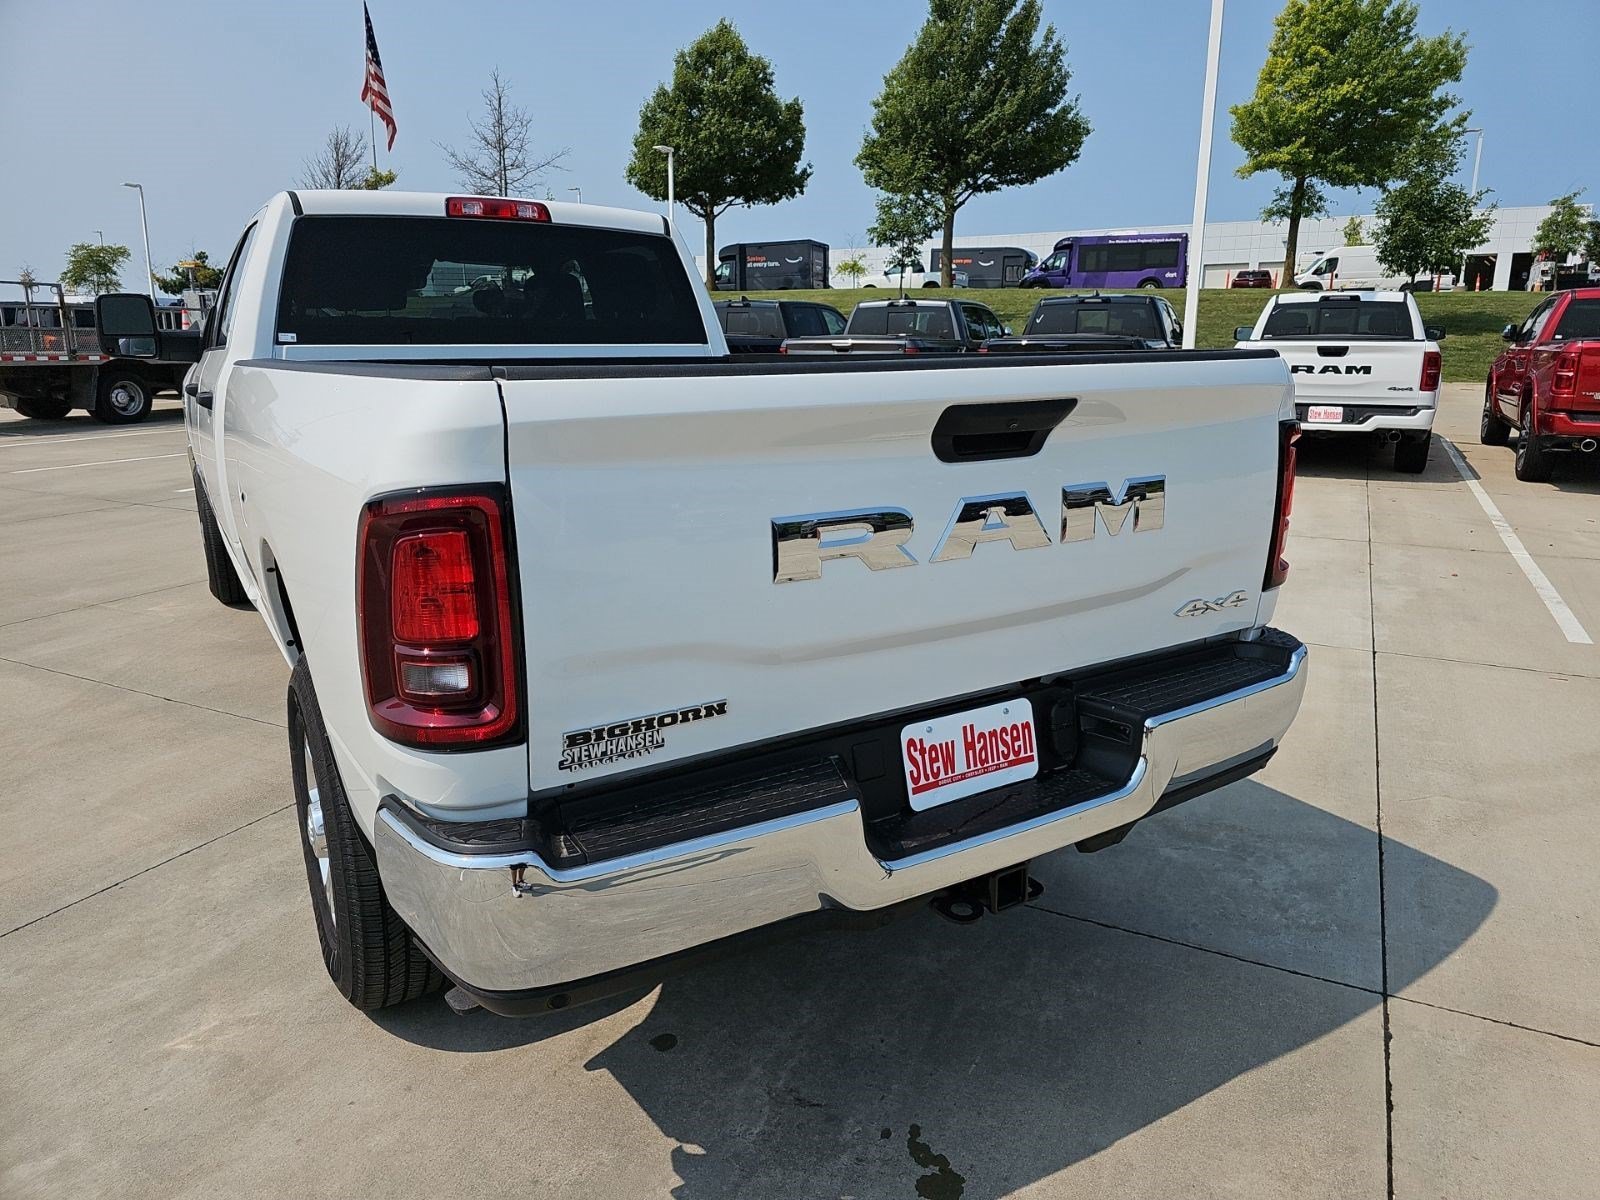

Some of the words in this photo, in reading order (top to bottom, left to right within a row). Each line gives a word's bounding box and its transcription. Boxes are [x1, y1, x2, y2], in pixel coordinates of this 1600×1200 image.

[746, 255, 767, 263] Savings
[1291, 365, 1372, 375] RAM
[1308, 408, 1322, 420] Stew
[1323, 408, 1342, 420] Hansen
[771, 474, 1167, 584] RAM
[1175, 589, 1249, 617] 4x4
[563, 699, 728, 748] BIGHORN
[562, 742, 603, 765] STEW
[606, 729, 664, 755] HANSEN
[570, 755, 619, 773] DODGE
[624, 746, 656, 760] CITY
[906, 737, 956, 786] Stew
[962, 720, 1034, 770] Hansen
